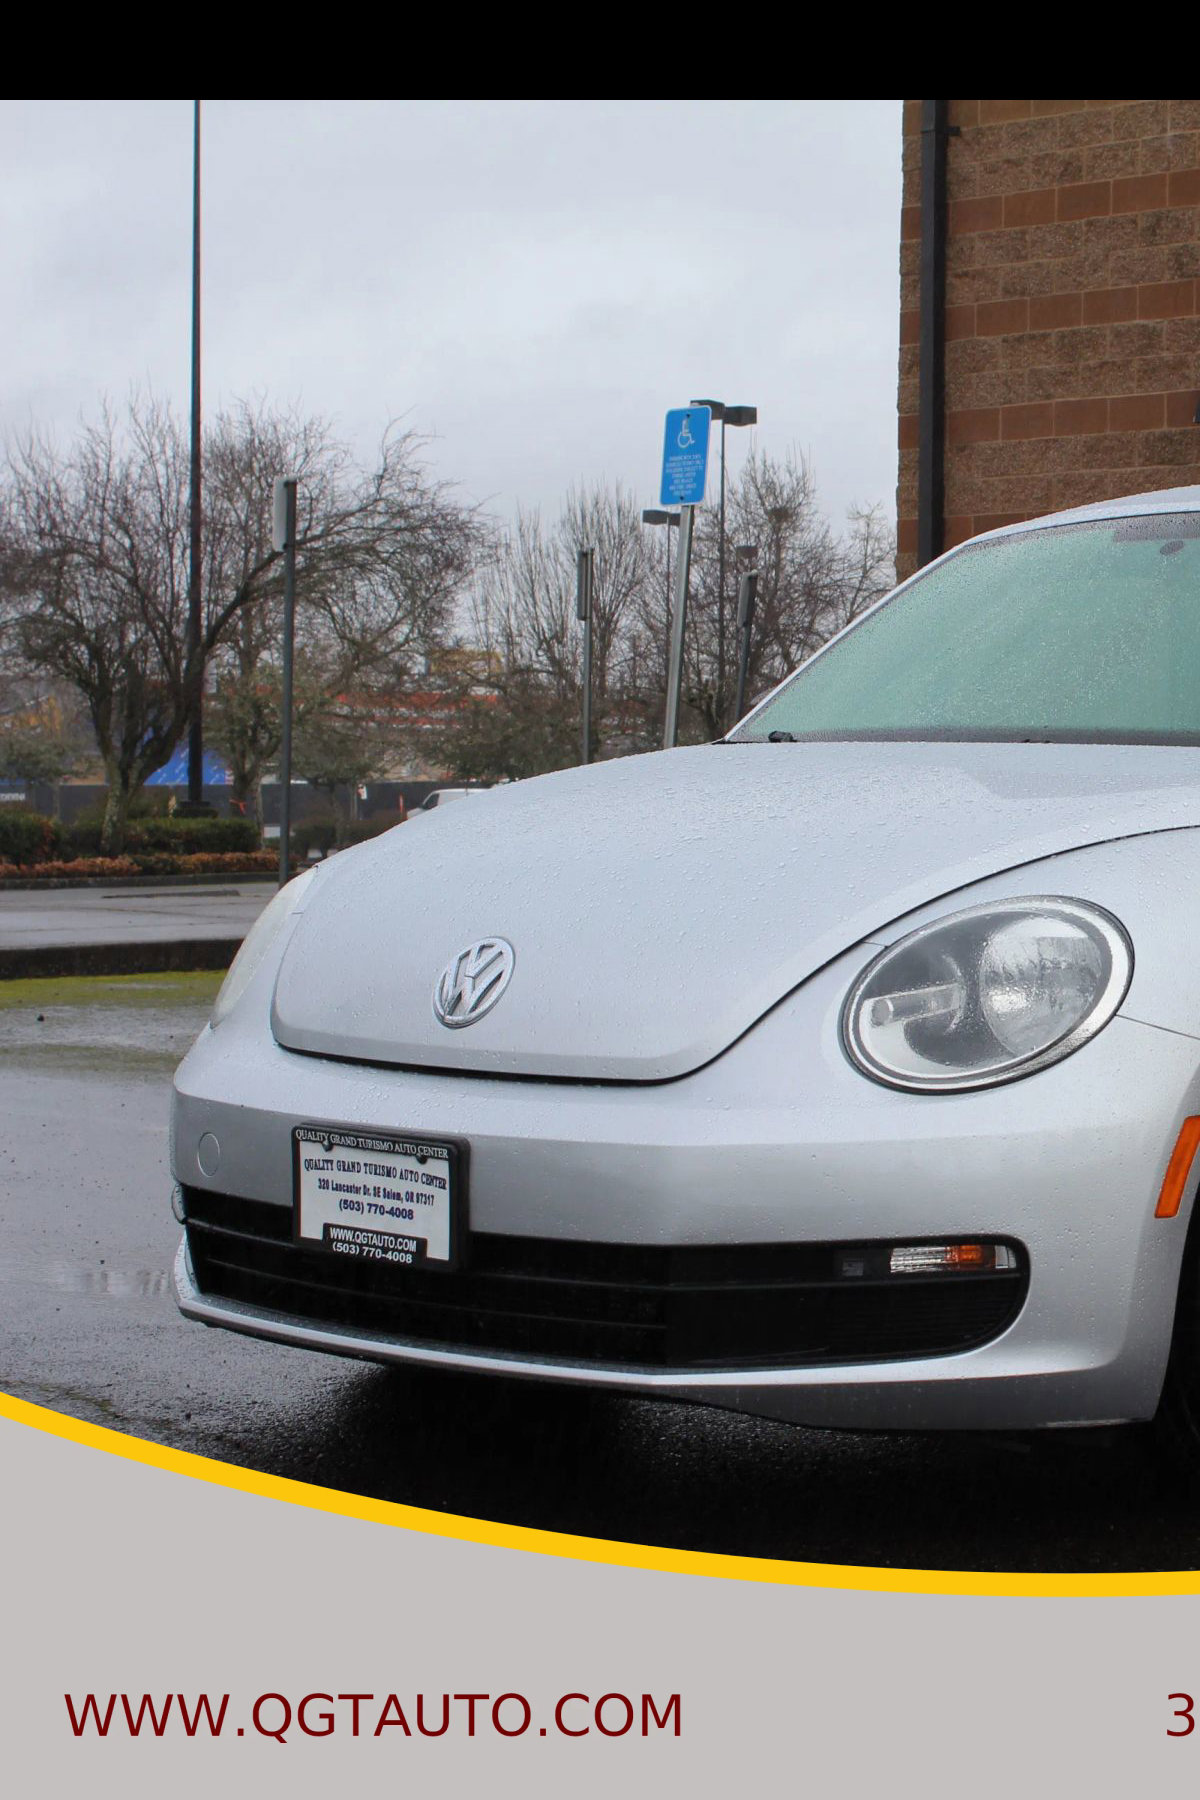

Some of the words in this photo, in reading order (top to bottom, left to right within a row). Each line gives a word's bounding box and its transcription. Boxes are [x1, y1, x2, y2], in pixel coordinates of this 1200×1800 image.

[296, 1129, 329, 1144] QUALITY
[330, 1135, 356, 1148] GRAND
[357, 1138, 393, 1151] TURISMO
[395, 1143, 416, 1154] AUTO
[417, 1146, 448, 1158] CENTER
[305, 1159, 334, 1172] QUALITY
[337, 1162, 361, 1173] GRAND
[364, 1163, 397, 1178] TURISMO
[399, 1168, 419, 1182] AUTO
[421, 1171, 447, 1190] CENTER
[318, 1179, 329, 1189] 320
[331, 1180, 361, 1195] Lancaster
[373, 1187, 381, 1197] SE
[382, 1188, 403, 1203] Salem,
[339, 1198, 364, 1214] (503)
[367, 1203, 413, 1220] 770-4008
[330, 1228, 417, 1252] WWW.QGTAUTO.COM
[332, 1242, 359, 1256] (503)
[362, 1247, 412, 1263] 770-4008
